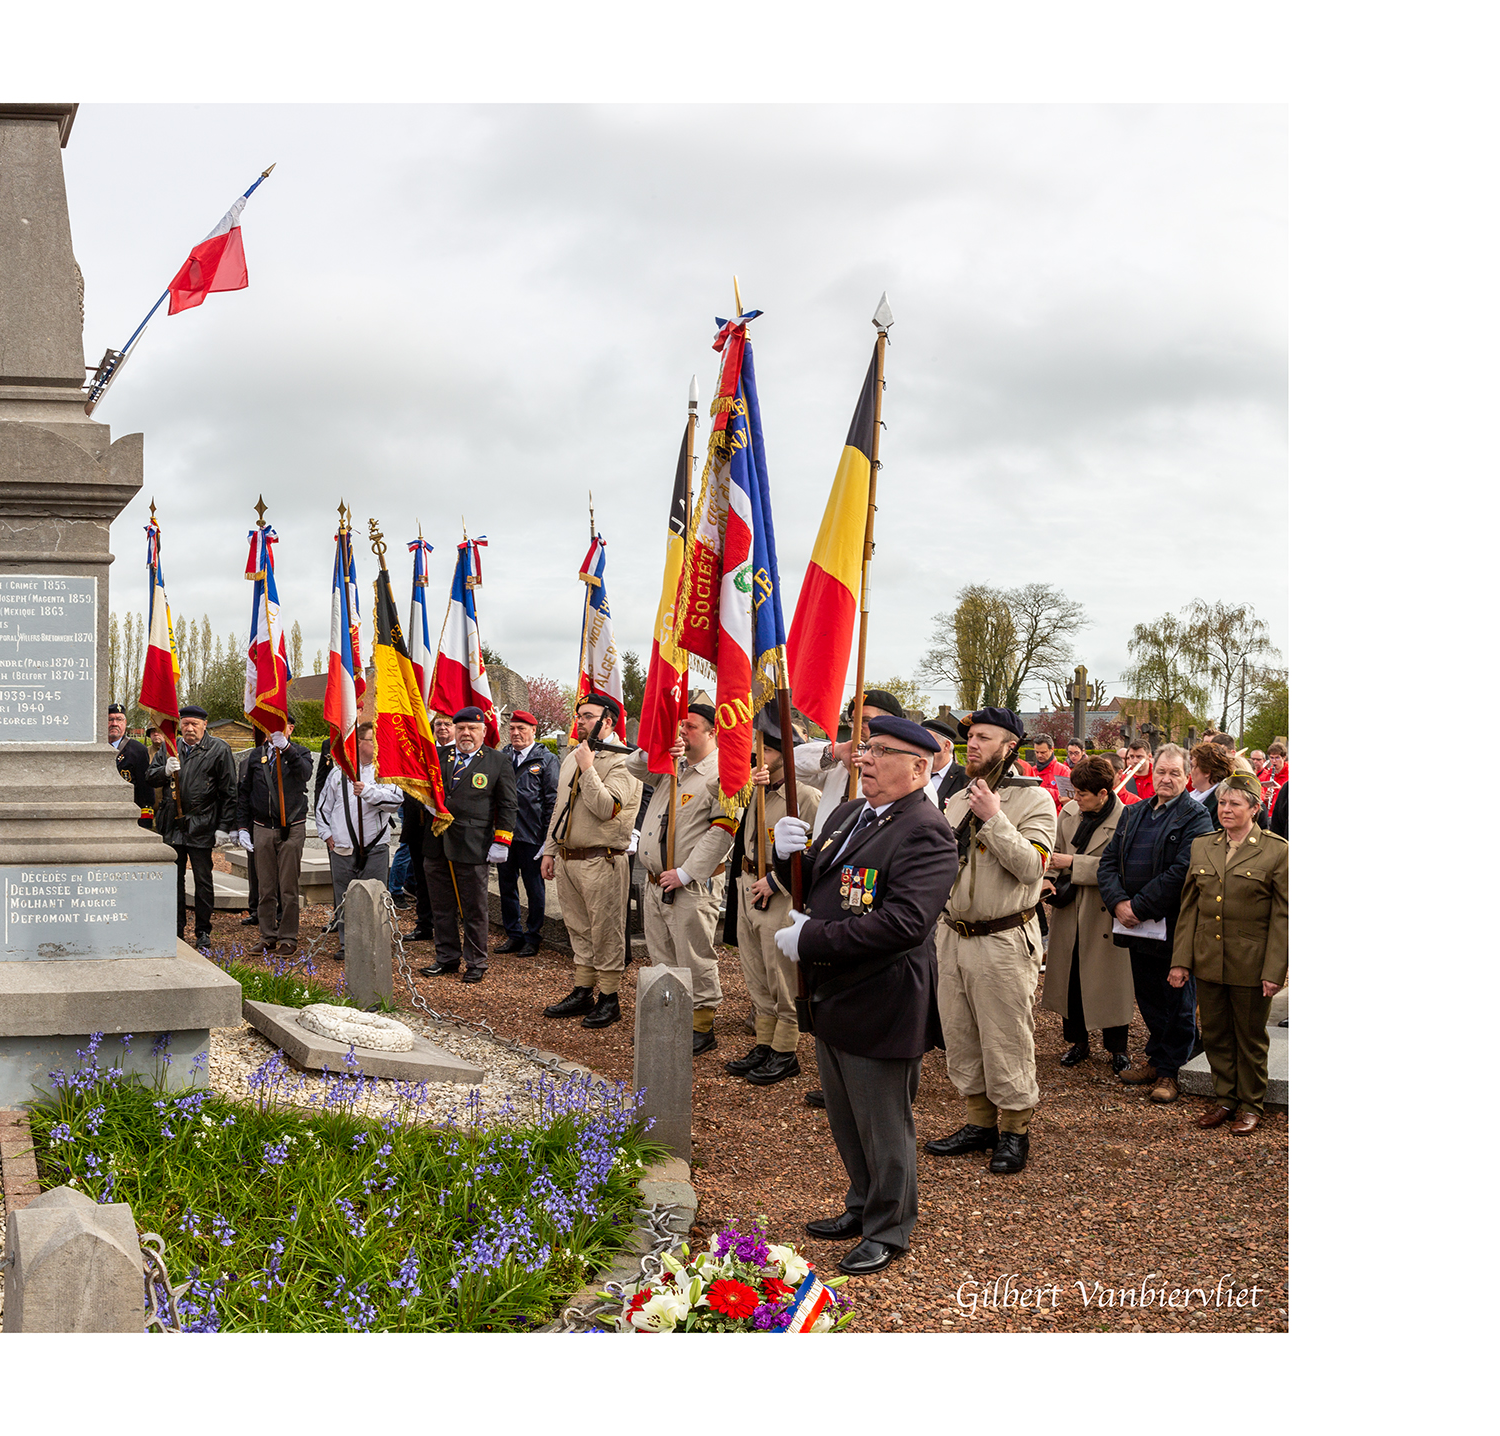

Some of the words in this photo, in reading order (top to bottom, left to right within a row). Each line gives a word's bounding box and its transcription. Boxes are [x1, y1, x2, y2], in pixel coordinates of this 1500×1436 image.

[690, 533, 716, 630] SOCIÉTÉ
[0, 690, 62, 702] 1939-1945
[17, 702, 45, 713] 1940
[41, 714, 70, 726] 1942
[21, 870, 67, 883] DÉCÉDÉS
[71, 874, 83, 882] EN
[87, 869, 164, 882] DÉPORTATION
[10, 884, 71, 896] DELBASSÉE
[10, 898, 65, 909] MOLHANT
[71, 898, 117, 908] MAURICE
[10, 911, 80, 923] DEFROMONT
